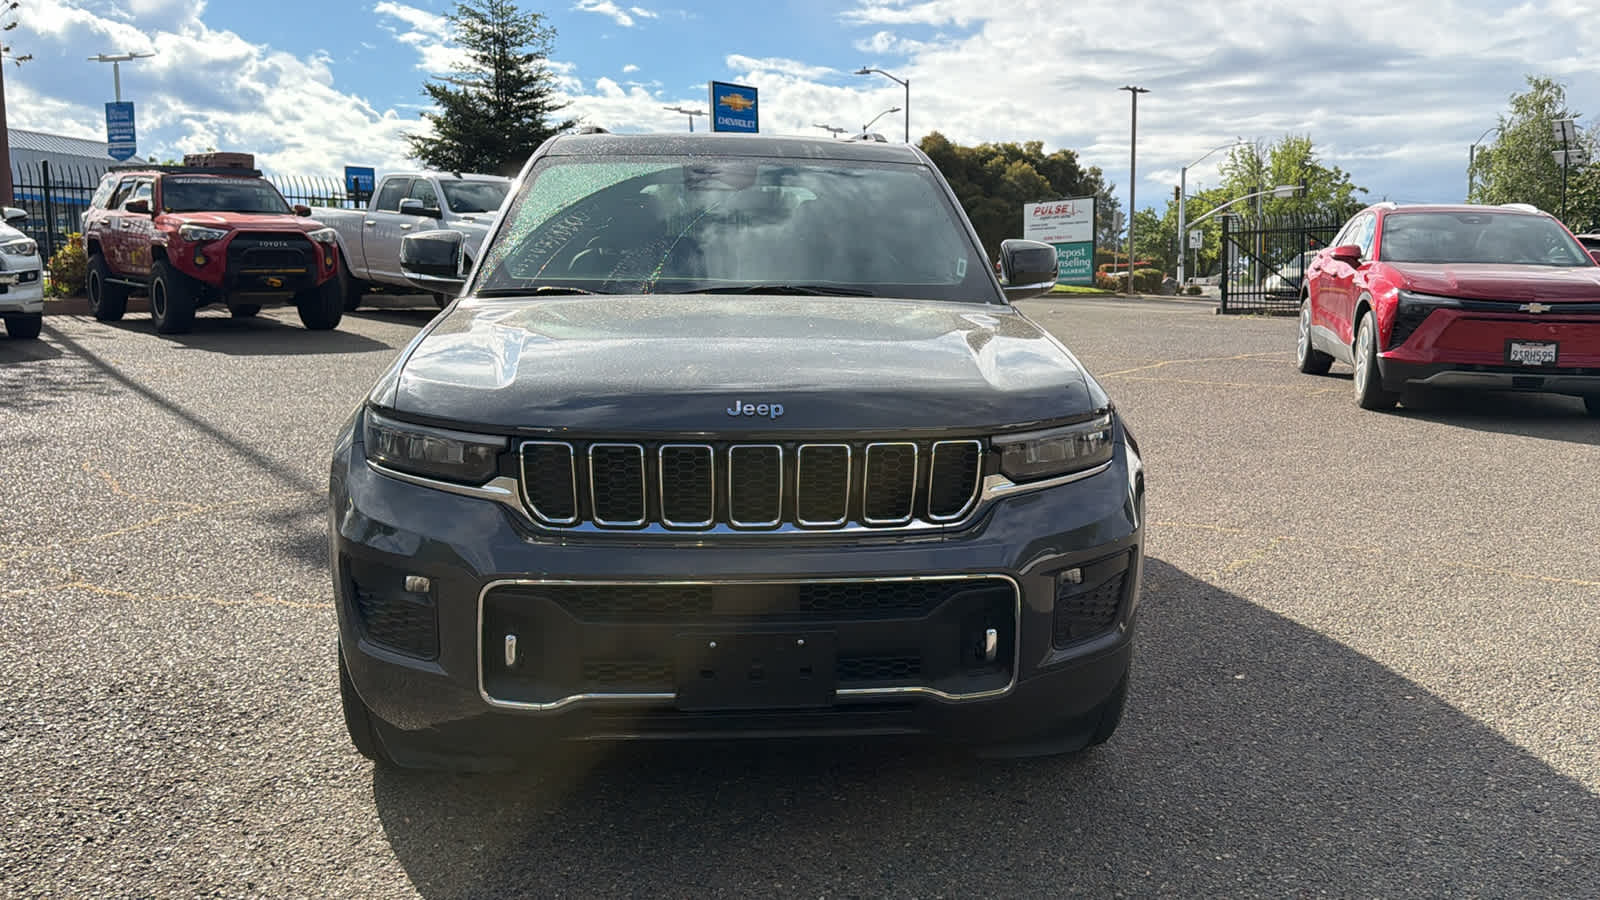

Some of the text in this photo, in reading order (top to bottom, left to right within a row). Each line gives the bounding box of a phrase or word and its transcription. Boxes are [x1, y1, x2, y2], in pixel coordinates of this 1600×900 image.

[718, 116, 755, 128] CHEVROLET
[1033, 204, 1068, 216] PULSE
[259, 240, 288, 248] TOYOTA
[1057, 247, 1085, 259] depost
[1058, 257, 1091, 270] nseling
[727, 399, 784, 419] Jeep
